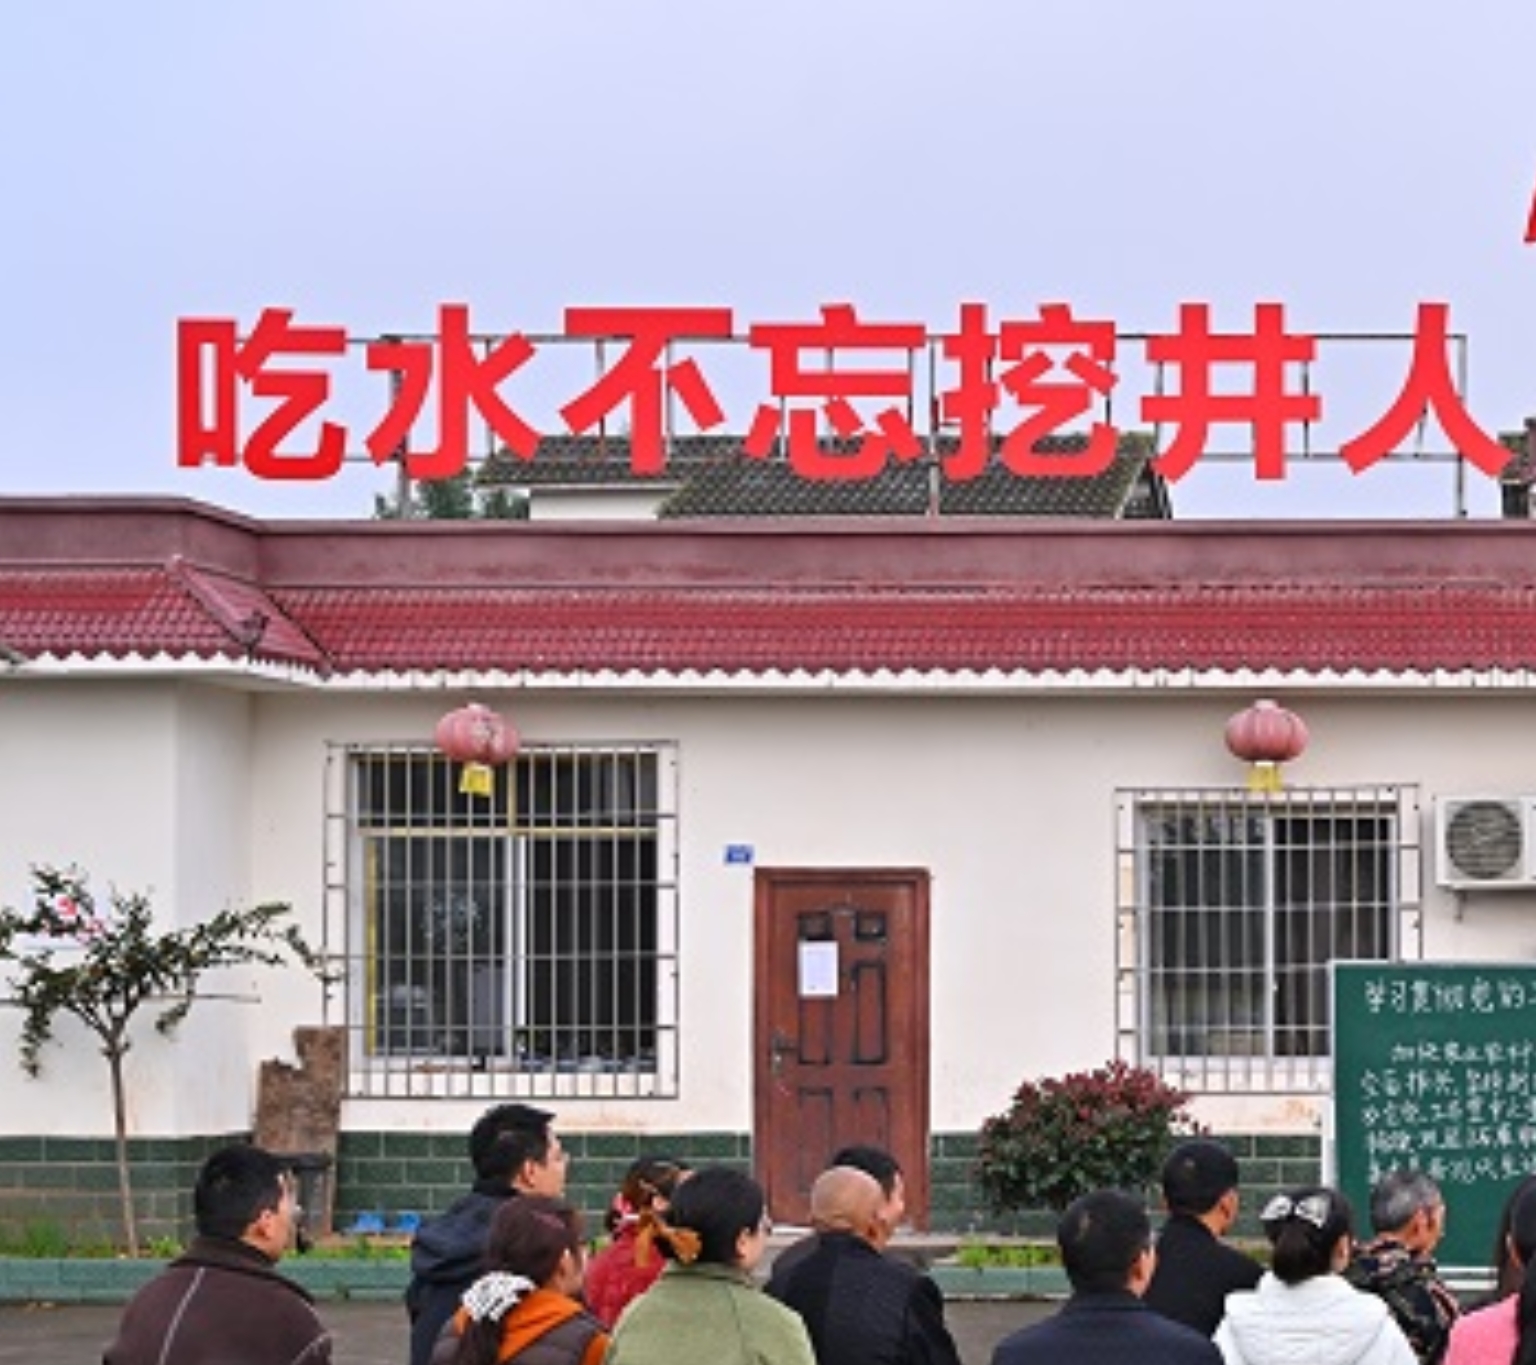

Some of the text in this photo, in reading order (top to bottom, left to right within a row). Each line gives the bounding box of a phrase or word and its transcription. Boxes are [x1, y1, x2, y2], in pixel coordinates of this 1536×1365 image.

[176, 302, 1512, 483] 吃水不忘挖井人
